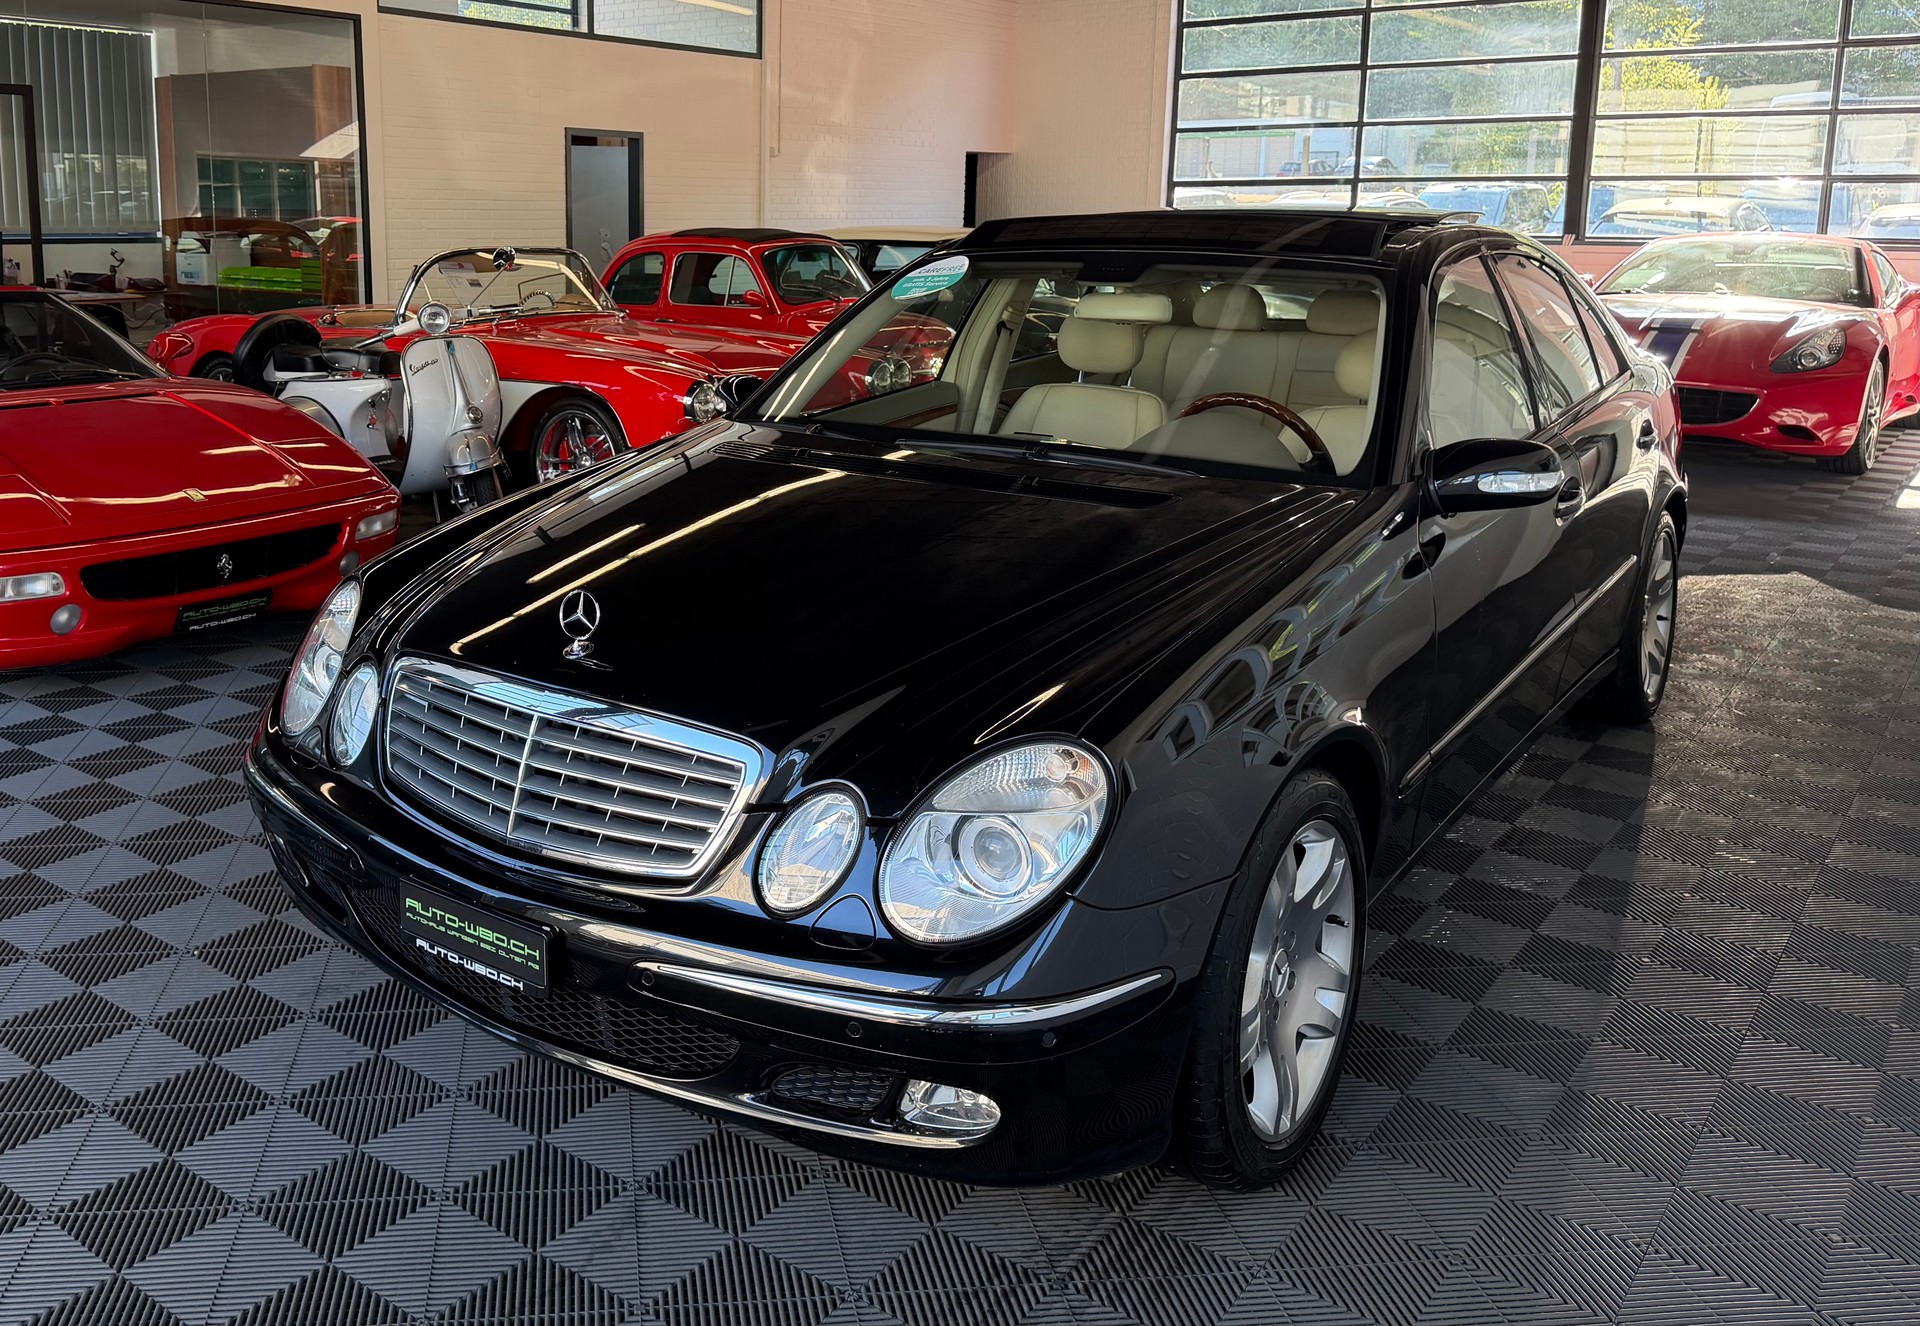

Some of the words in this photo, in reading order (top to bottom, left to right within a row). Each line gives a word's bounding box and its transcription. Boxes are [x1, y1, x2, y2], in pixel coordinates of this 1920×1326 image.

[918, 263, 965, 274] CAREFREE
[183, 596, 267, 618] AUTO-WBO.CH
[189, 612, 257, 631] AUTO-WBO.CH
[405, 897, 540, 961] AUTO-WBO.CH
[405, 912, 446, 933] AUTOHAUS
[480, 942, 497, 954] BEI
[498, 949, 526, 966] OLTEN
[527, 960, 540, 972] AG
[415, 938, 524, 991] AUTO-WBO.CH
